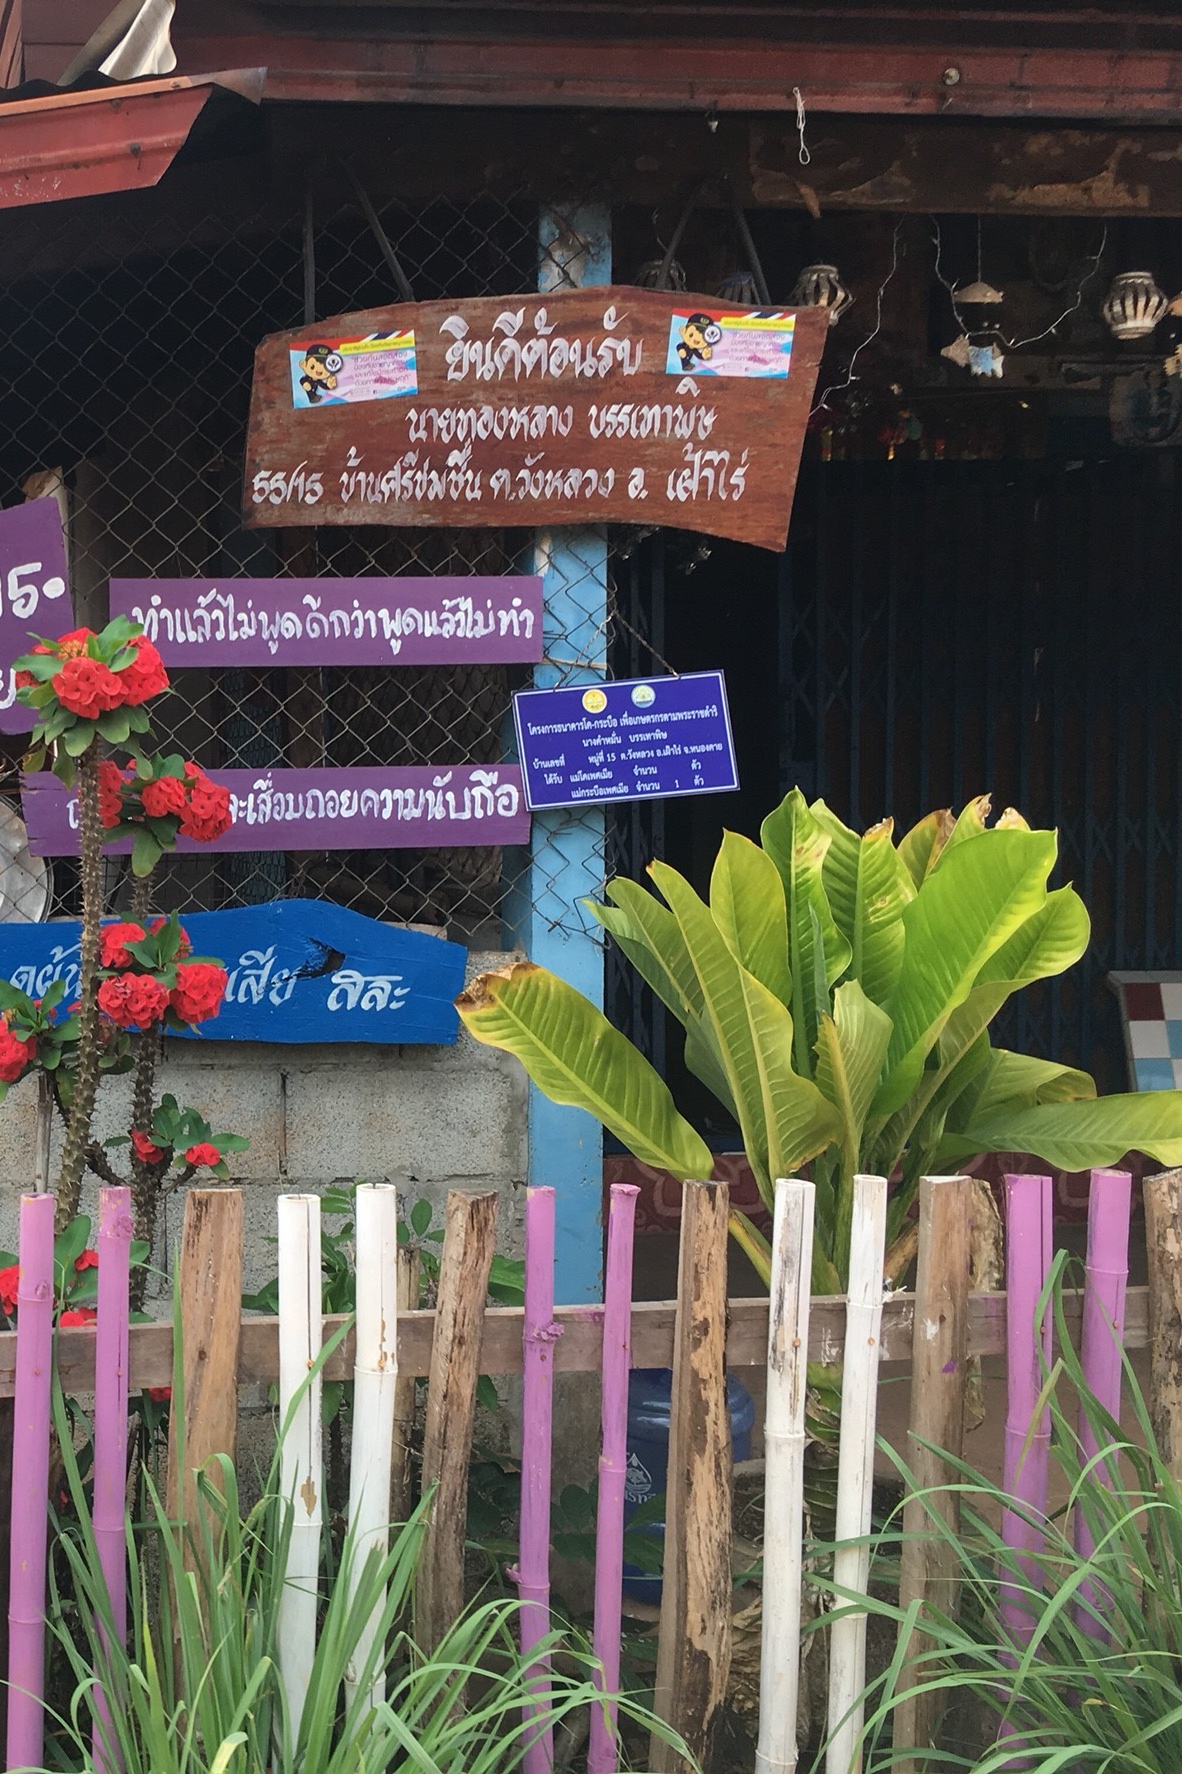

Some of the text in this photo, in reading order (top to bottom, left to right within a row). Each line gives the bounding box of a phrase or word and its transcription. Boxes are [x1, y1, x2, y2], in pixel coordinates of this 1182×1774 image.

[439, 305, 643, 383] ยินดีต้อนรับ
[405, 404, 574, 444] นายทองหลาง
[252, 460, 324, 505] 55/15
[606, 752, 616, 762] 15
[633, 764, 658, 776] จำนวน
[691, 759, 702, 771] ตัว
[636, 780, 661, 792] จำนวน
[674, 779, 680, 789] 1
[694, 775, 705, 787] ตัว
